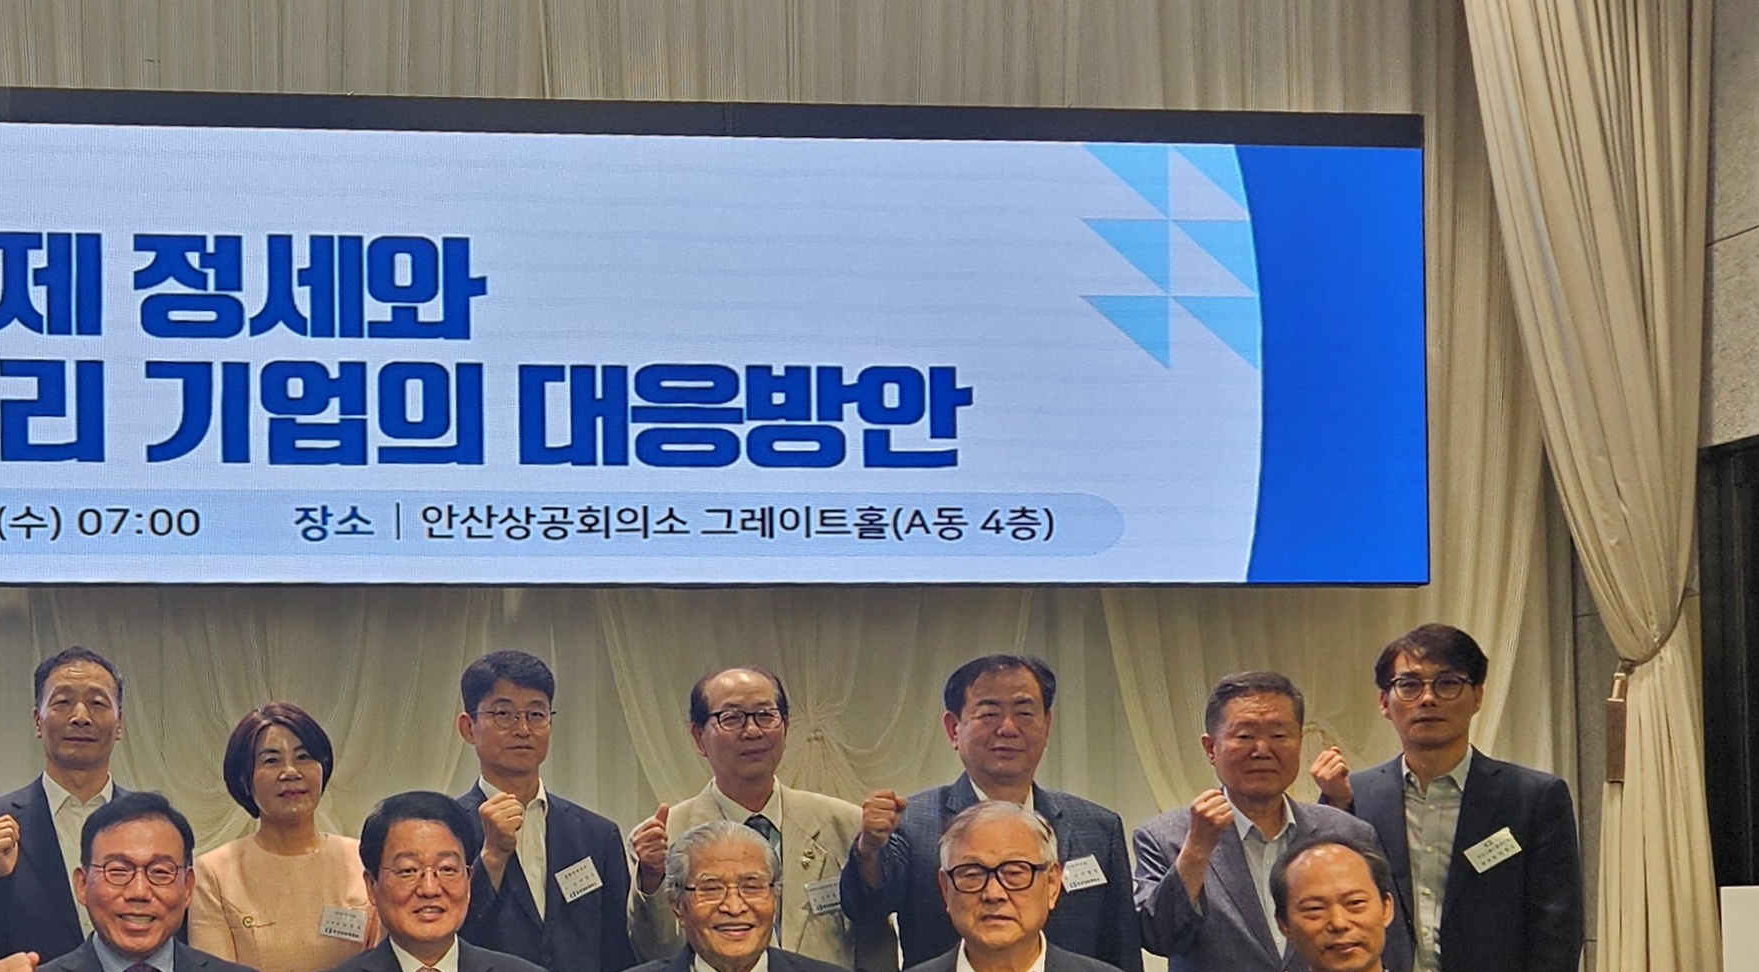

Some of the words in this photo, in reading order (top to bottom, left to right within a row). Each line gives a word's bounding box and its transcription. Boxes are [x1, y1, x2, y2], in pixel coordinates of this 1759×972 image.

[132, 233, 488, 341] 정세와
[144, 359, 485, 466] 기업의
[517, 363, 974, 469] 대응방안
[78, 508, 201, 537] 07:00
[294, 504, 375, 542] 장소
[421, 504, 691, 541] 안산상공회의소
[700, 505, 969, 542] 그레이트홀(A동
[980, 506, 1054, 542] 4층)
